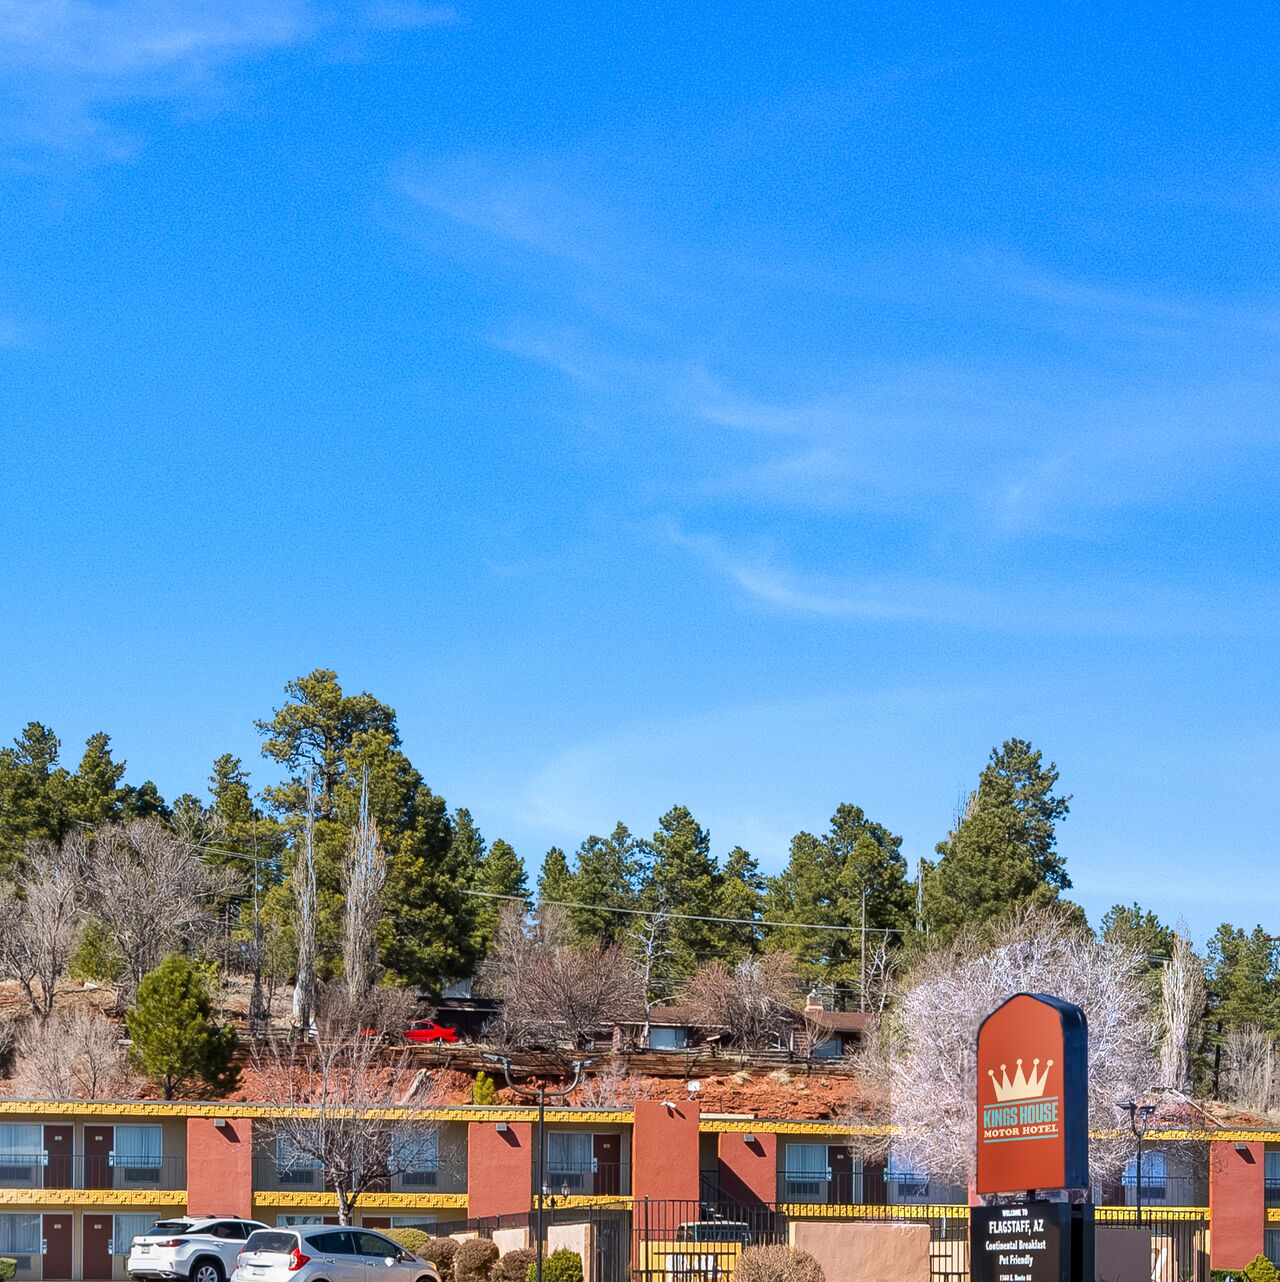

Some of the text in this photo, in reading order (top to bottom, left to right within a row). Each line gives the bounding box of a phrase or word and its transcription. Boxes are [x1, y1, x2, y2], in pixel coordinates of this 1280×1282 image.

[984, 1102, 1059, 1128] KINGS HOUSE
[984, 1124, 1059, 1138] MOTOR HOTEL
[1022, 1208, 1028, 1216] TO
[989, 1219, 1044, 1236] FLAGSTAFF, AZ
[985, 1239, 1046, 1251] Continental Breakfast
[999, 1254, 1033, 1267] Pet Friendly
